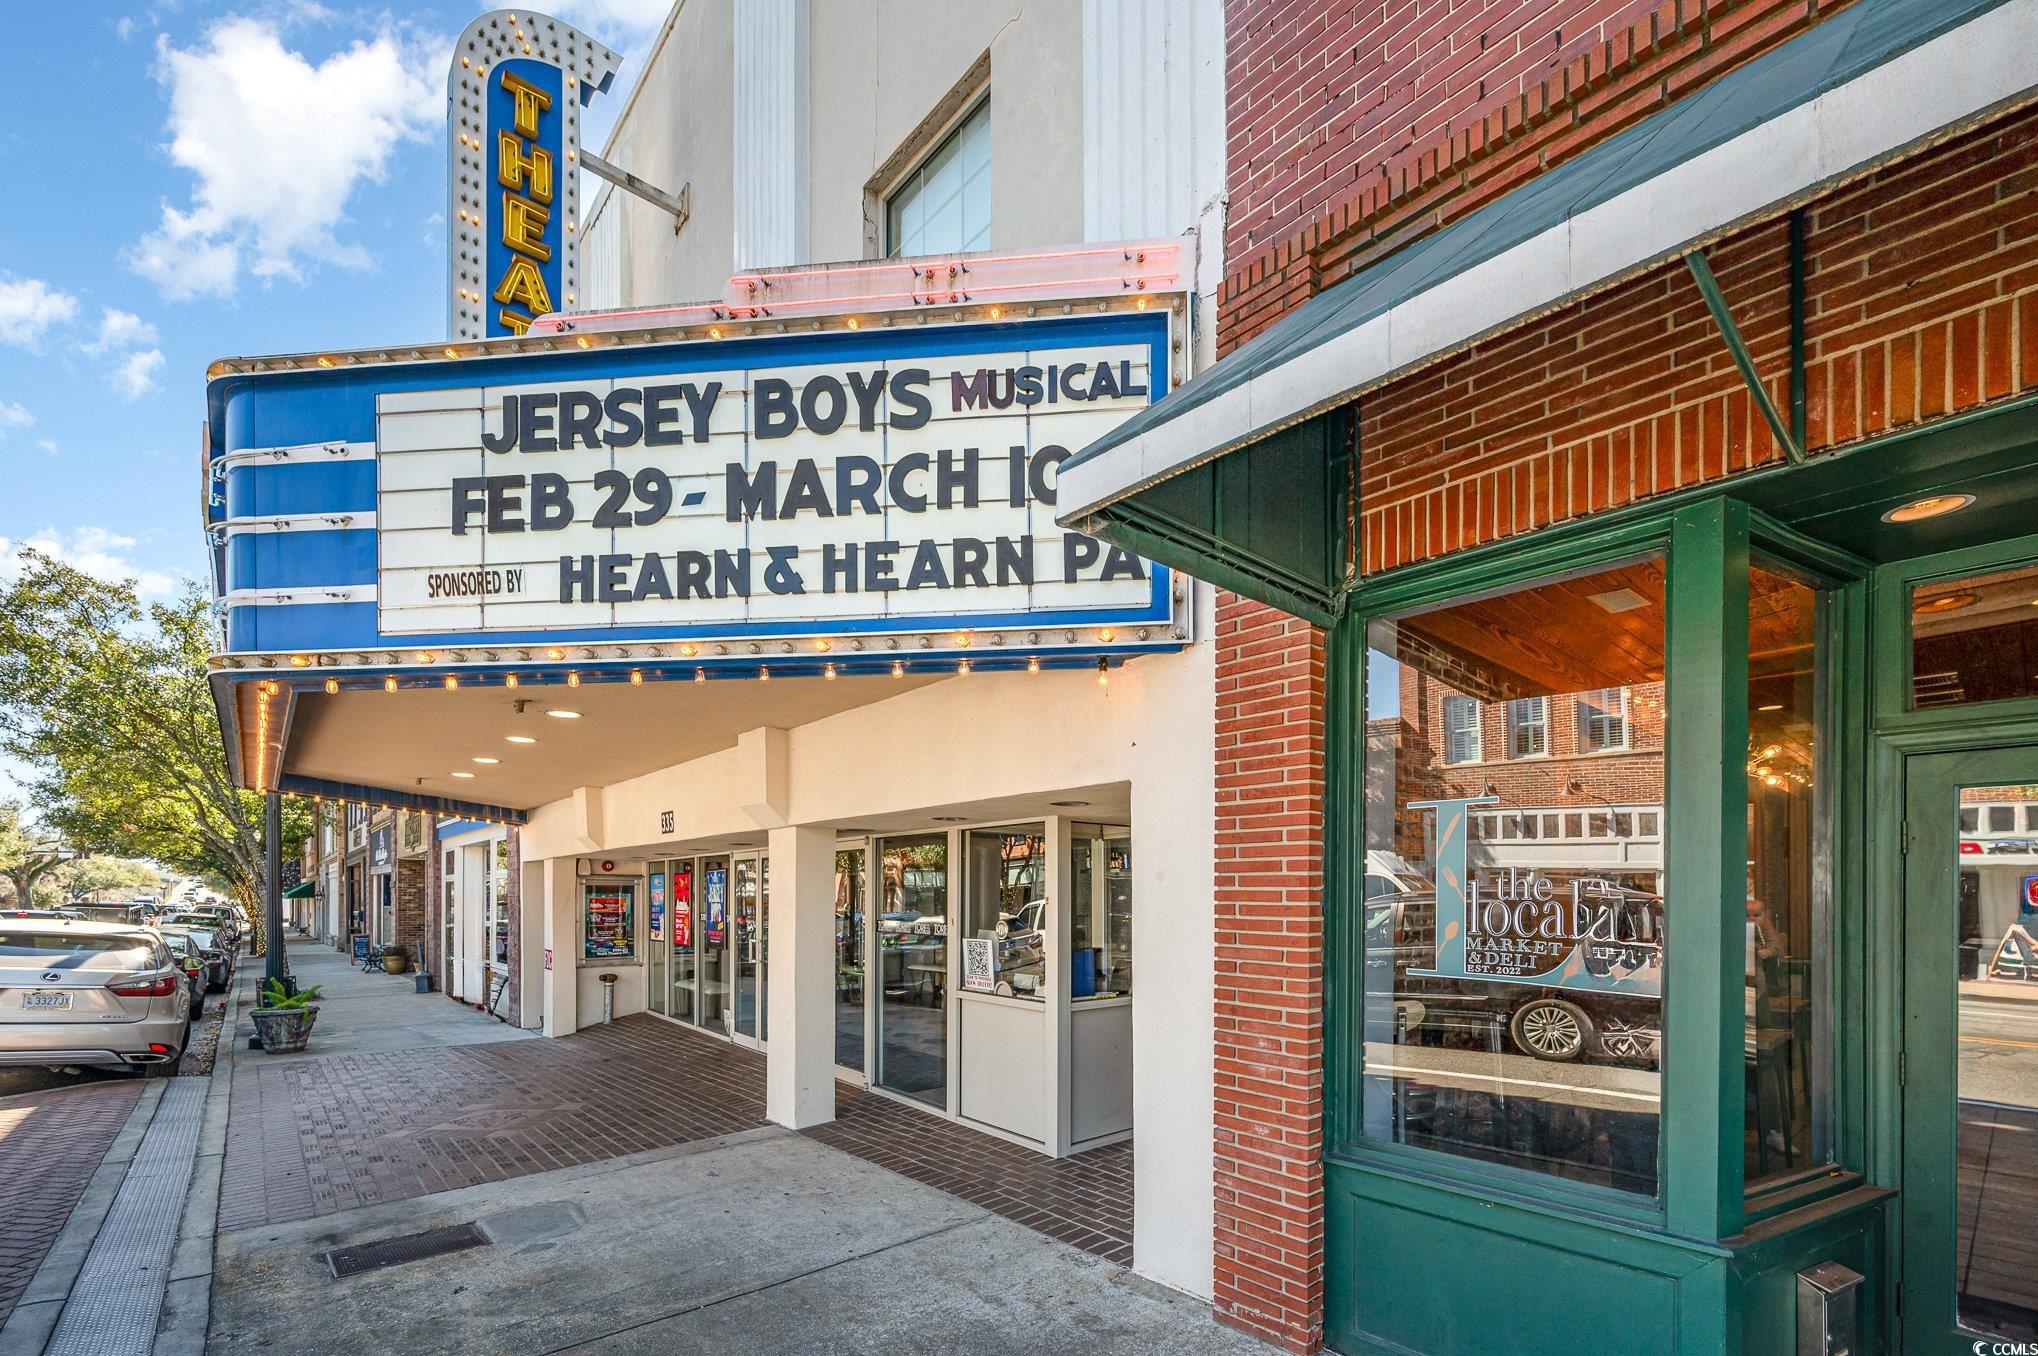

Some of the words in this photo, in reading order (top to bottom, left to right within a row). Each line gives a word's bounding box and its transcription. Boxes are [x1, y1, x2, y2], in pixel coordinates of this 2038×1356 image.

[481, 381, 723, 454] JERSEY
[754, 368, 932, 439] BOYS
[951, 360, 1147, 412] MUSICAL
[452, 472, 575, 535] FEB
[592, 467, 673, 527] 29
[725, 448, 979, 522] MARCH
[427, 569, 501, 598] SPONSORED
[506, 569, 523, 593] BY
[560, 548, 750, 604] HEARN
[764, 545, 806, 595] &
[822, 535, 1034, 594] HEARN
[661, 813, 674, 832] 335
[1497, 867, 1553, 901] the
[1466, 937, 1562, 956] MARKET
[1467, 964, 1493, 973] EST.
[1496, 966, 1521, 975] 2022
